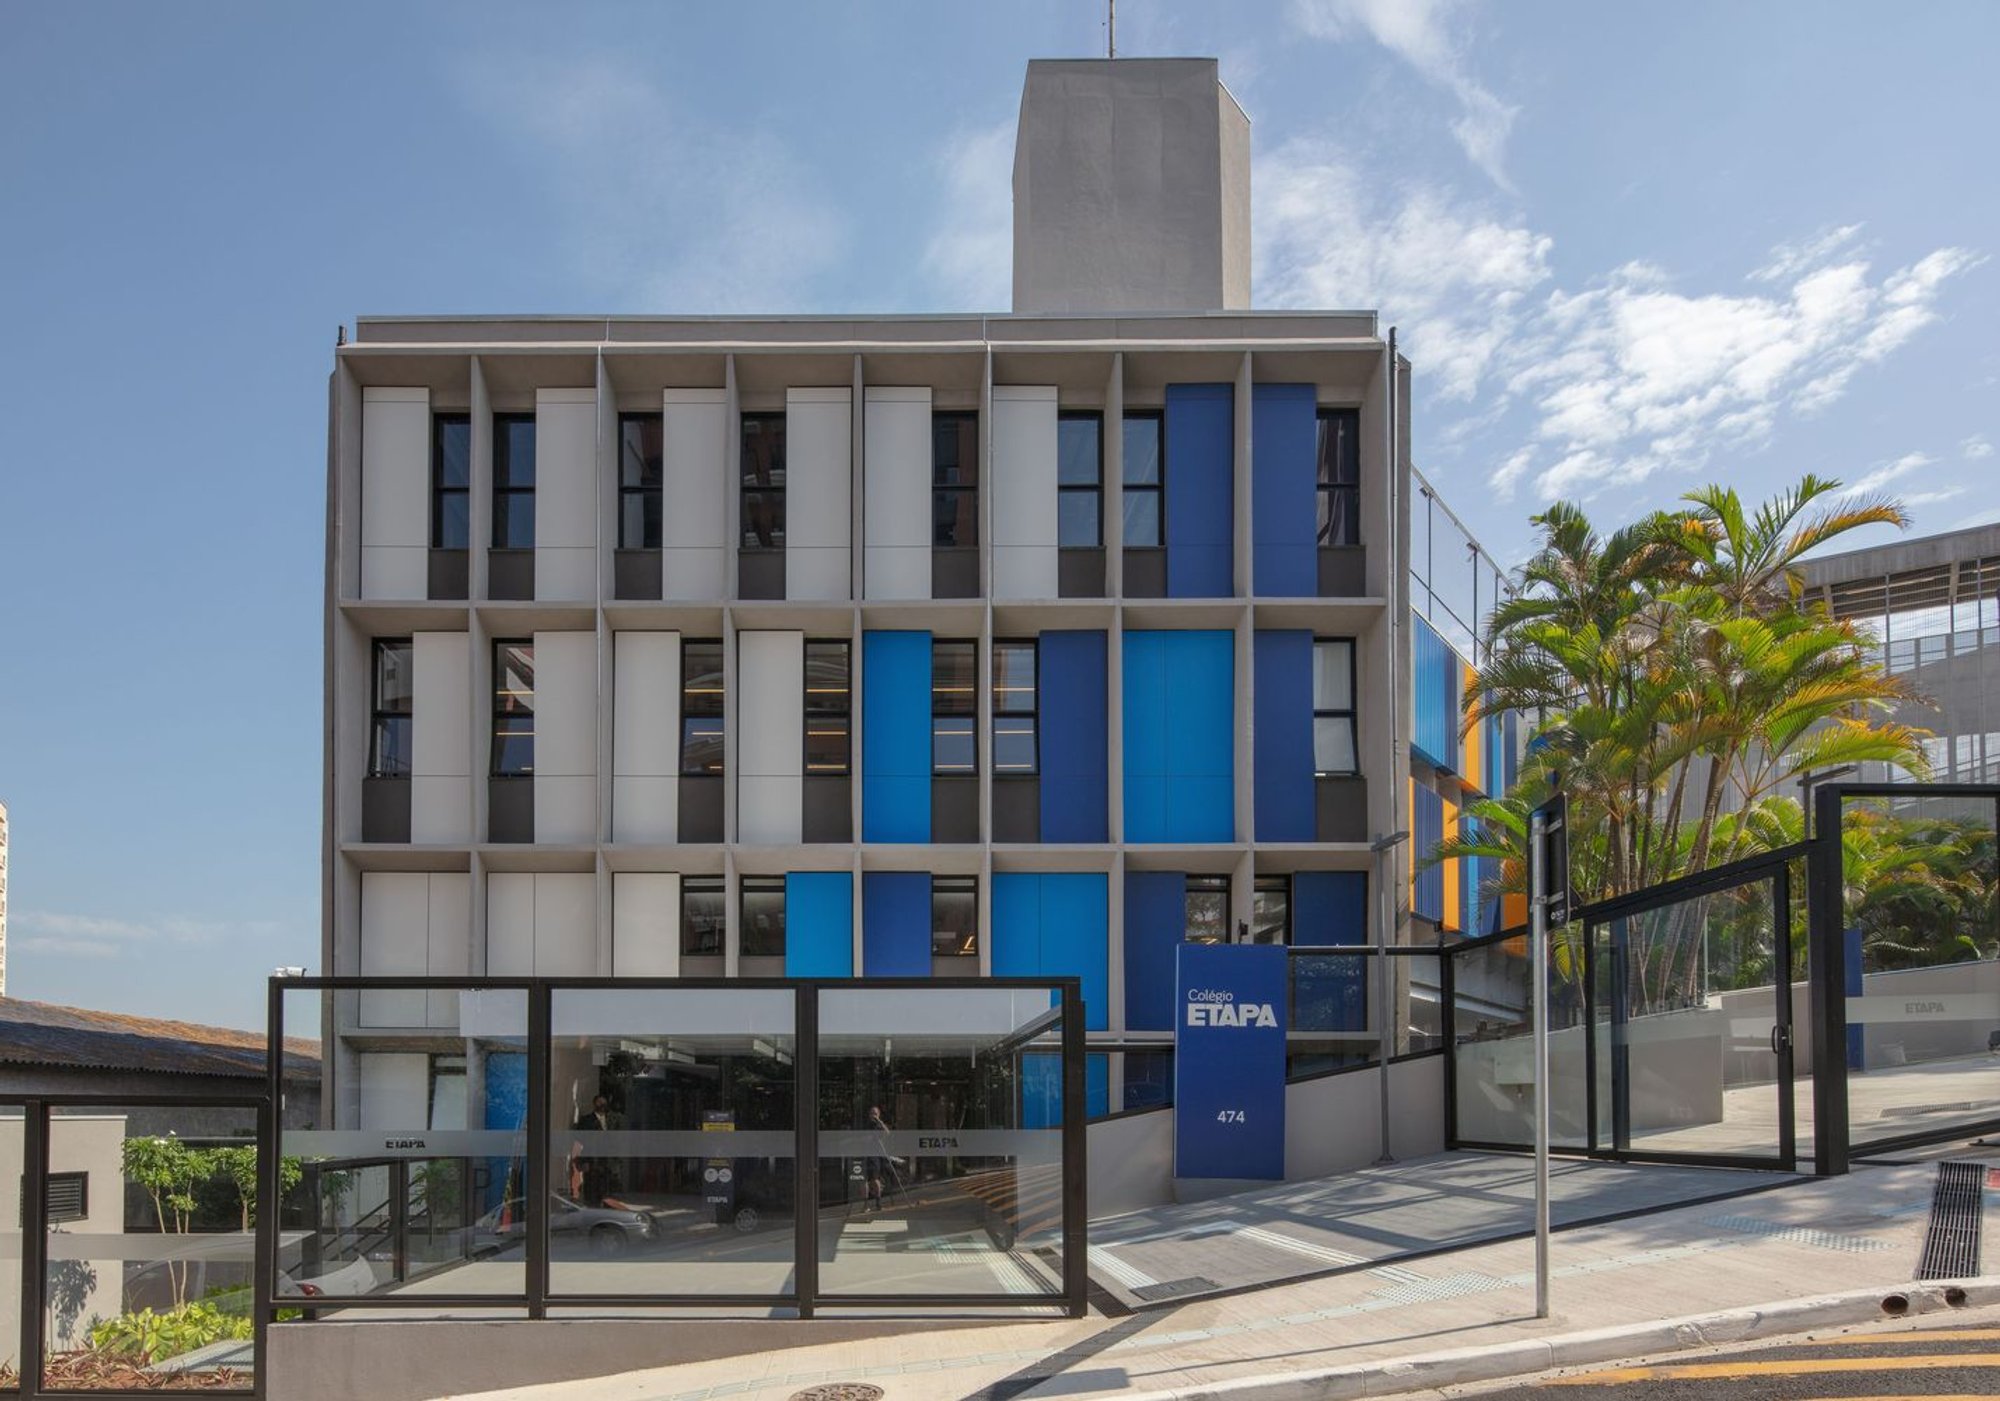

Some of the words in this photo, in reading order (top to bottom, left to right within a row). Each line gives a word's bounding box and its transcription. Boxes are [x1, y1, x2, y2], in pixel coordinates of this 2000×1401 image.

[1188, 989, 1233, 1003] Colégio
[1905, 1002, 1945, 1013] ETAPA
[1187, 1003, 1278, 1027] ETAPA
[1217, 1110, 1245, 1123] 474
[385, 1137, 425, 1148] ETAPA
[919, 1137, 958, 1148] ETAPA
